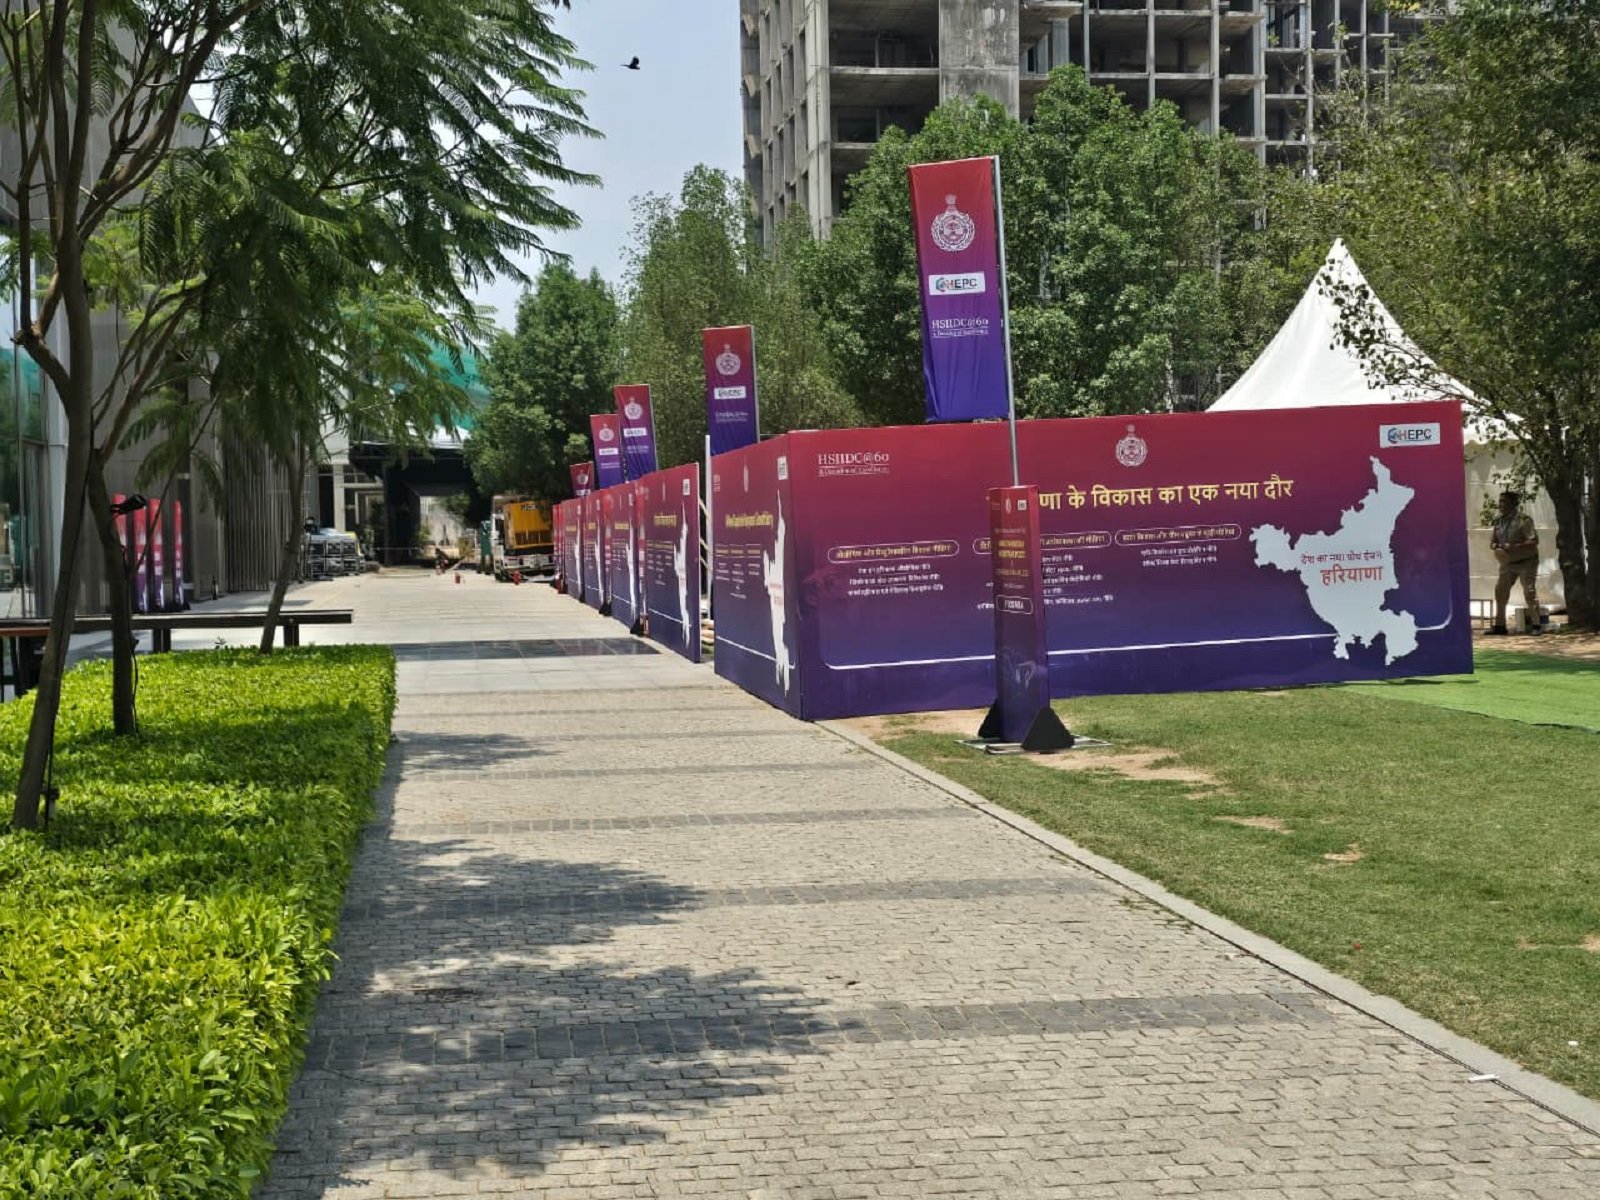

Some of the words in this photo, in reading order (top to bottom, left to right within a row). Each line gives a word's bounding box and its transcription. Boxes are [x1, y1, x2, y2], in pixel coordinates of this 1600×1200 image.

[947, 278, 978, 289] HEPC
[1398, 428, 1432, 441] HEPC
[818, 451, 890, 465] HSIIDC@60
[1066, 485, 1087, 509] के
[1091, 484, 1153, 508] विकास
[1157, 485, 1183, 504] का
[1188, 484, 1220, 505] एक
[1224, 480, 1260, 500] नया
[1263, 474, 1295, 499] दौर
[1320, 563, 1384, 586] हरियाणा
